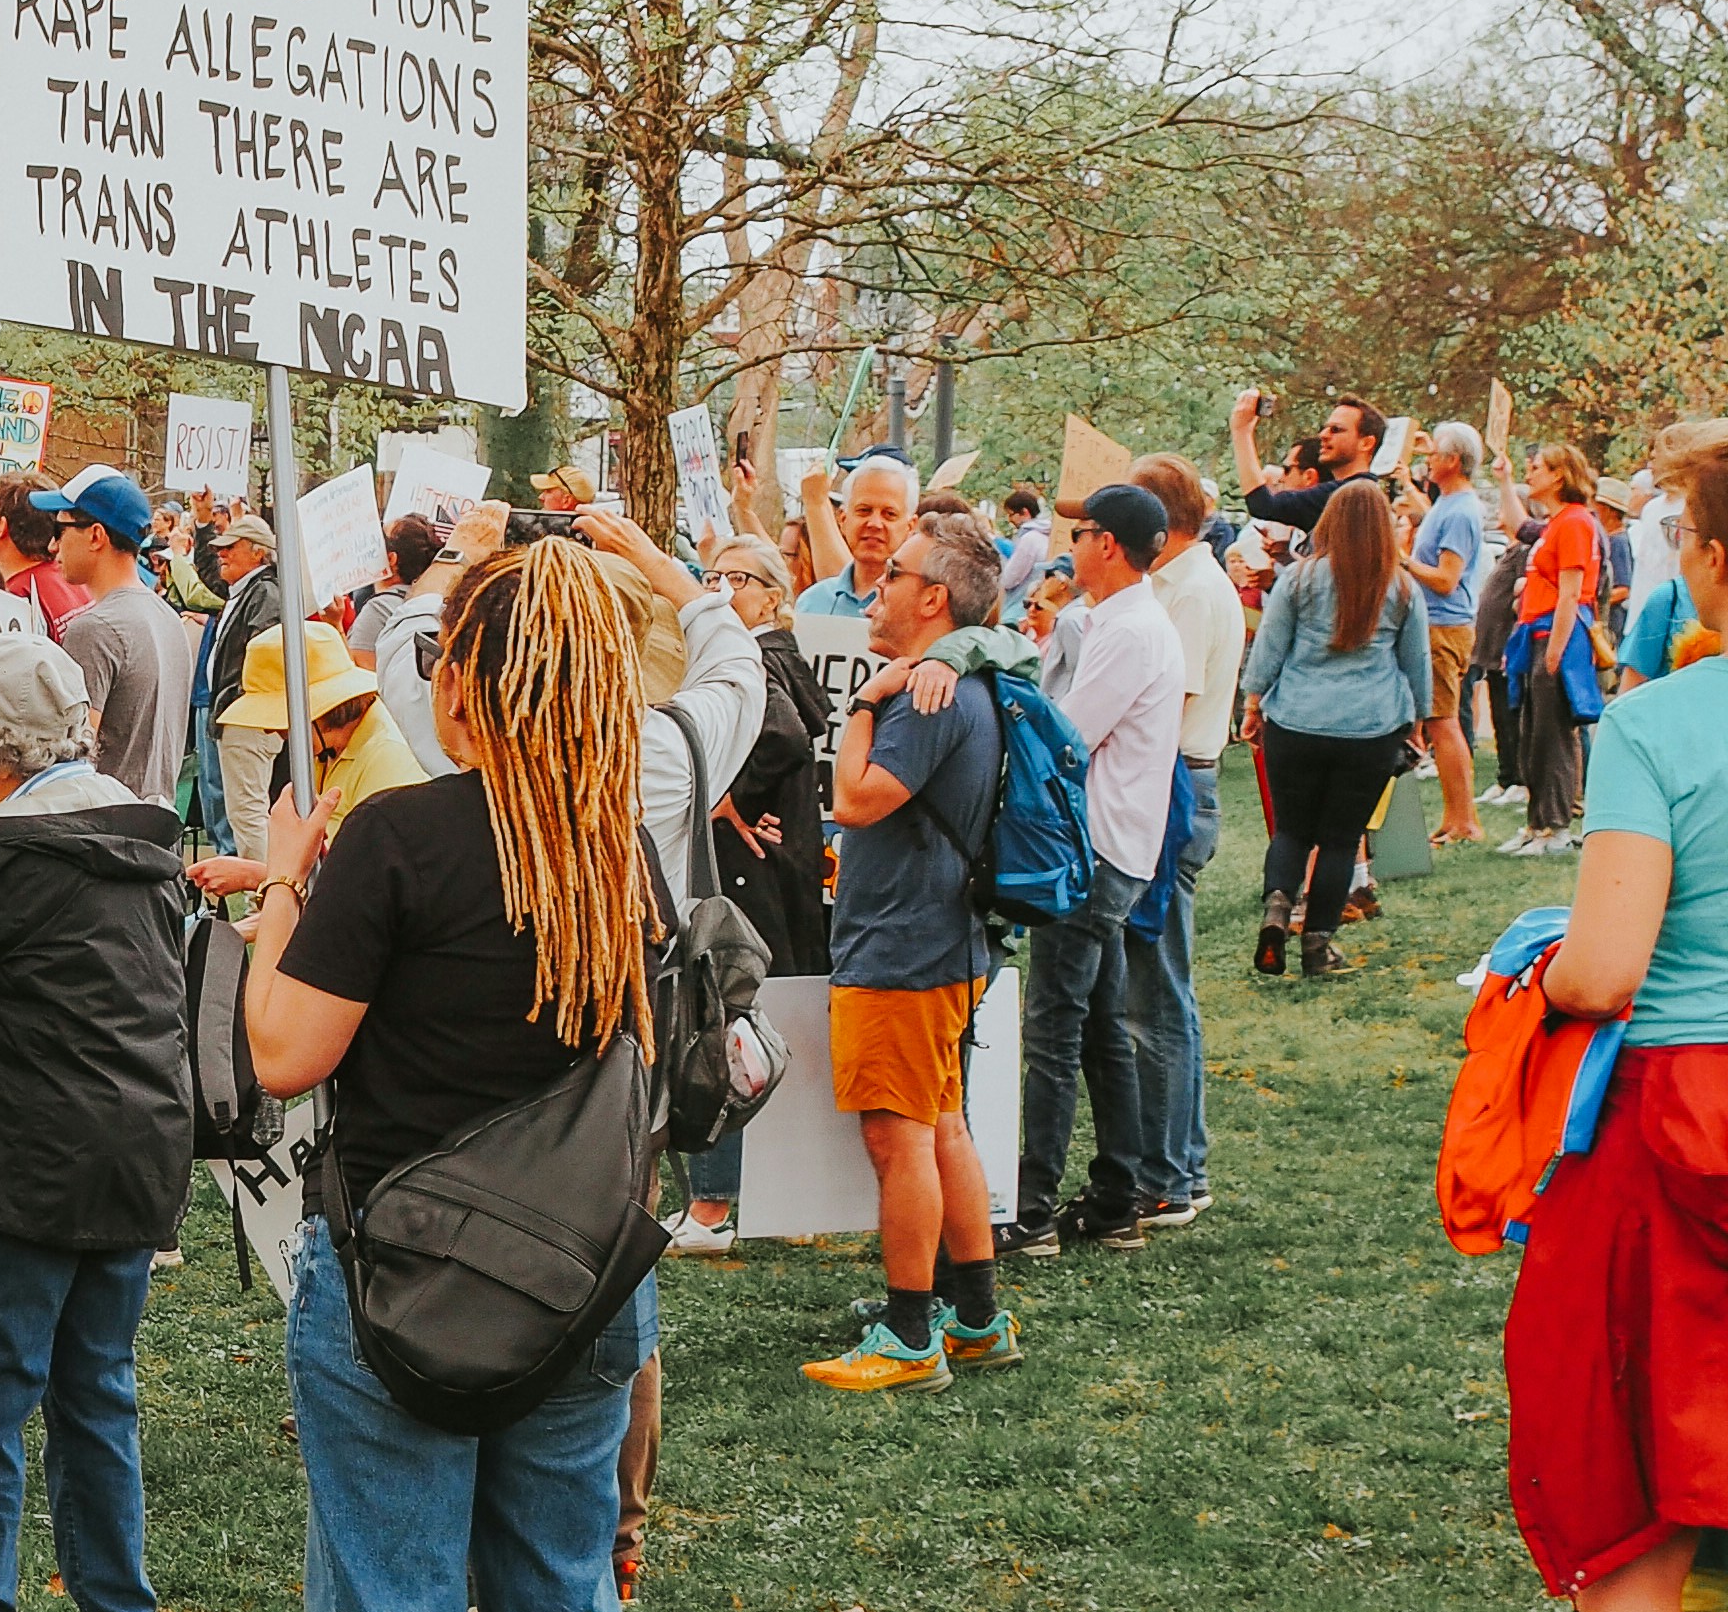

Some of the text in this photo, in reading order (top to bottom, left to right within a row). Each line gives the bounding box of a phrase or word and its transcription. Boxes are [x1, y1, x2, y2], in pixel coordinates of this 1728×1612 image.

[166, 4, 497, 138] ALLEGATIONS
[47, 77, 468, 224] THAN THERE ARE
[26, 165, 460, 313] TRANS ATHLETES
[66, 260, 454, 398] IN THE NCAA
[175, 423, 247, 474] RESIST!
